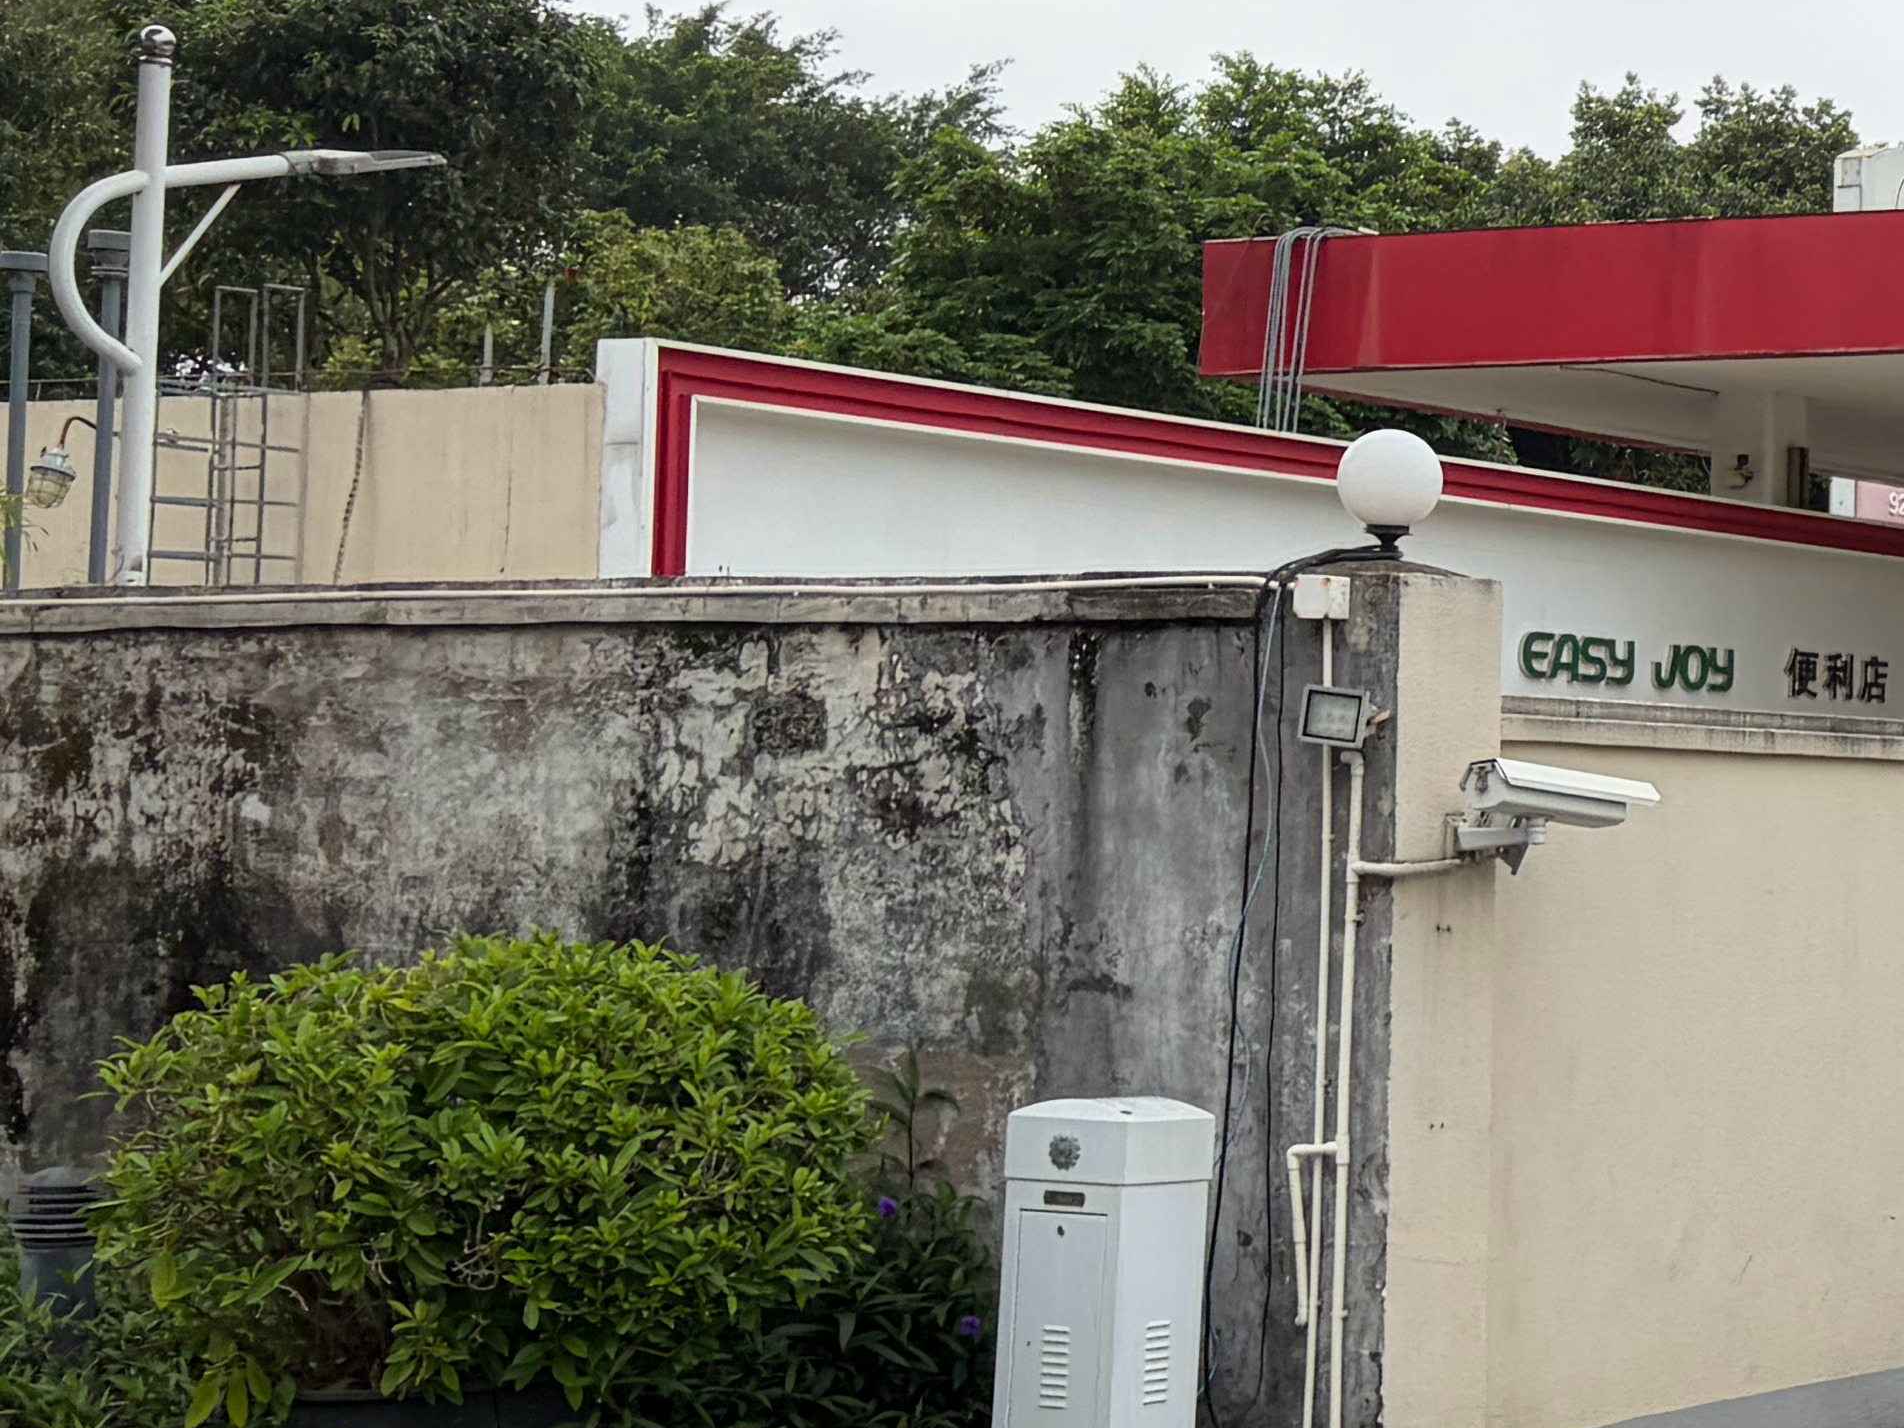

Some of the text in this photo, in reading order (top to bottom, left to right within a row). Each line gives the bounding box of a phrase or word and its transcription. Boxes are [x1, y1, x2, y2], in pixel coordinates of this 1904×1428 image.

[1518, 631, 1889, 704] EASY JOY 便利店
